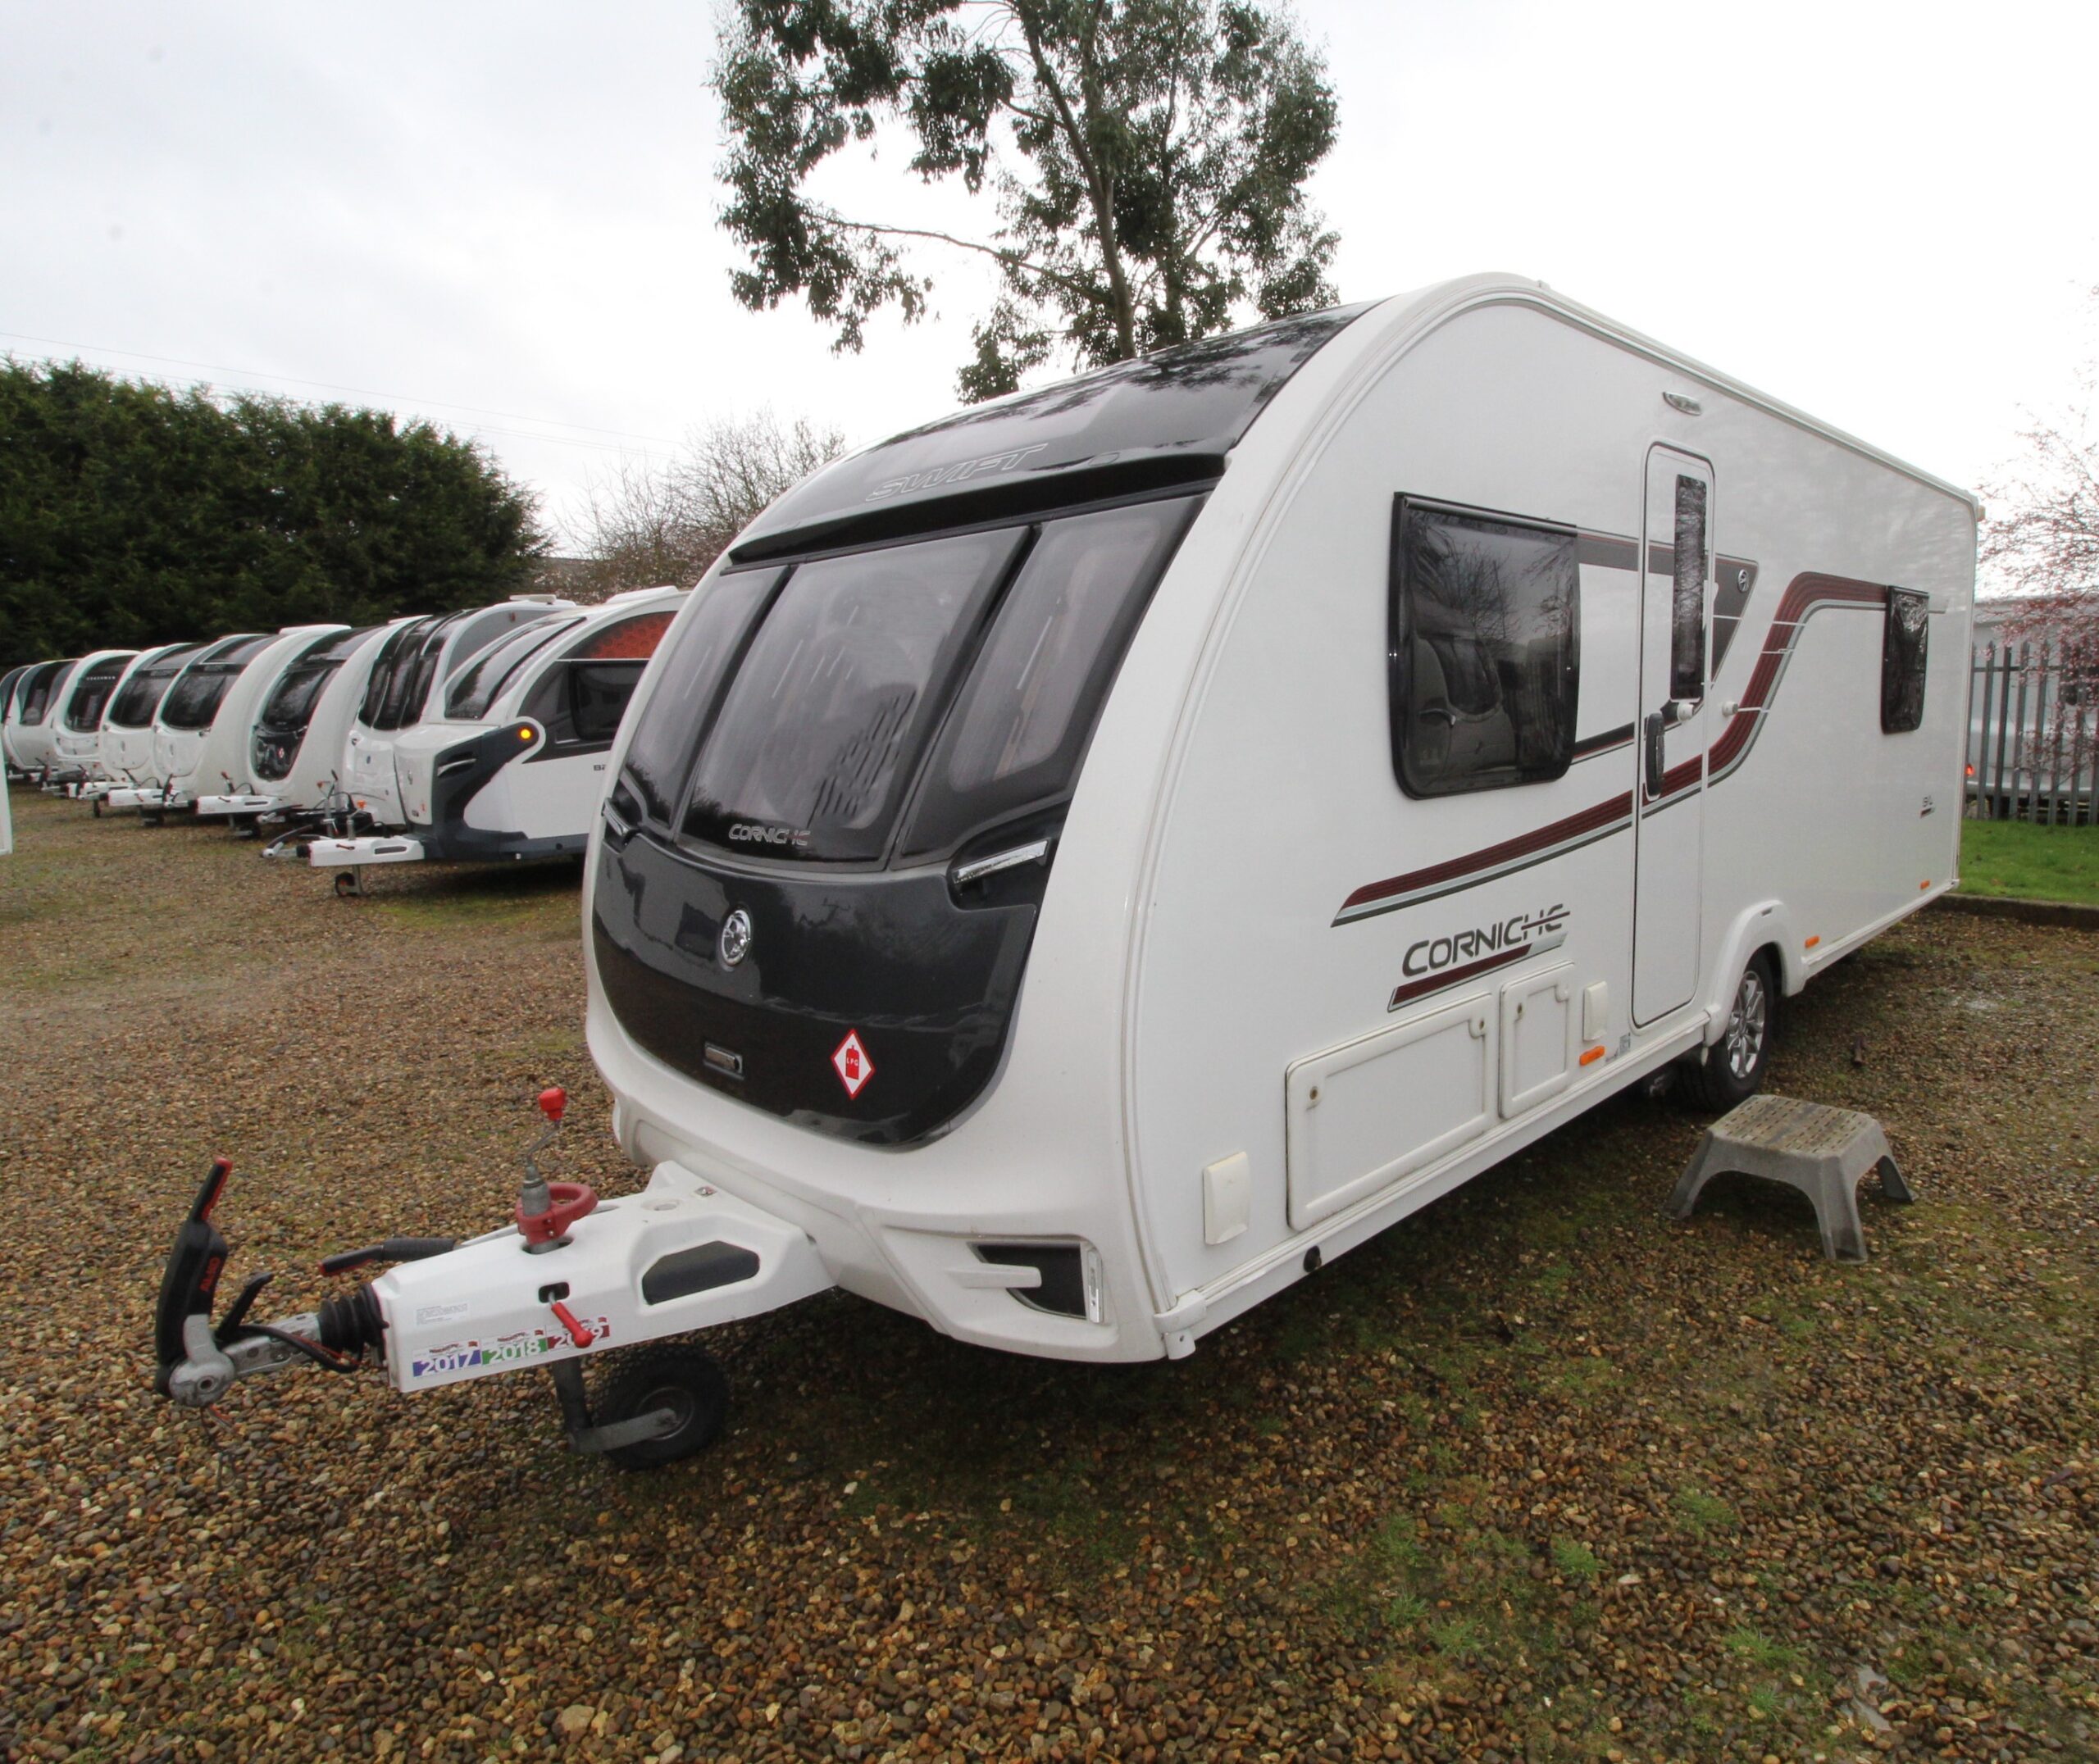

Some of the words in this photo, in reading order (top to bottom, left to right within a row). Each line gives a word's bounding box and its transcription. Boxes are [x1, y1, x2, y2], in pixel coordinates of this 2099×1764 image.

[866, 443, 1049, 502] SWIFT
[728, 823, 812, 846] CORNICHE
[1401, 903, 1569, 977] CORNICHE
[846, 1057, 858, 1066] LPG
[553, 1325, 604, 1349] 209
[420, 1349, 475, 1376] 2017
[488, 1338, 540, 1364] 2018
